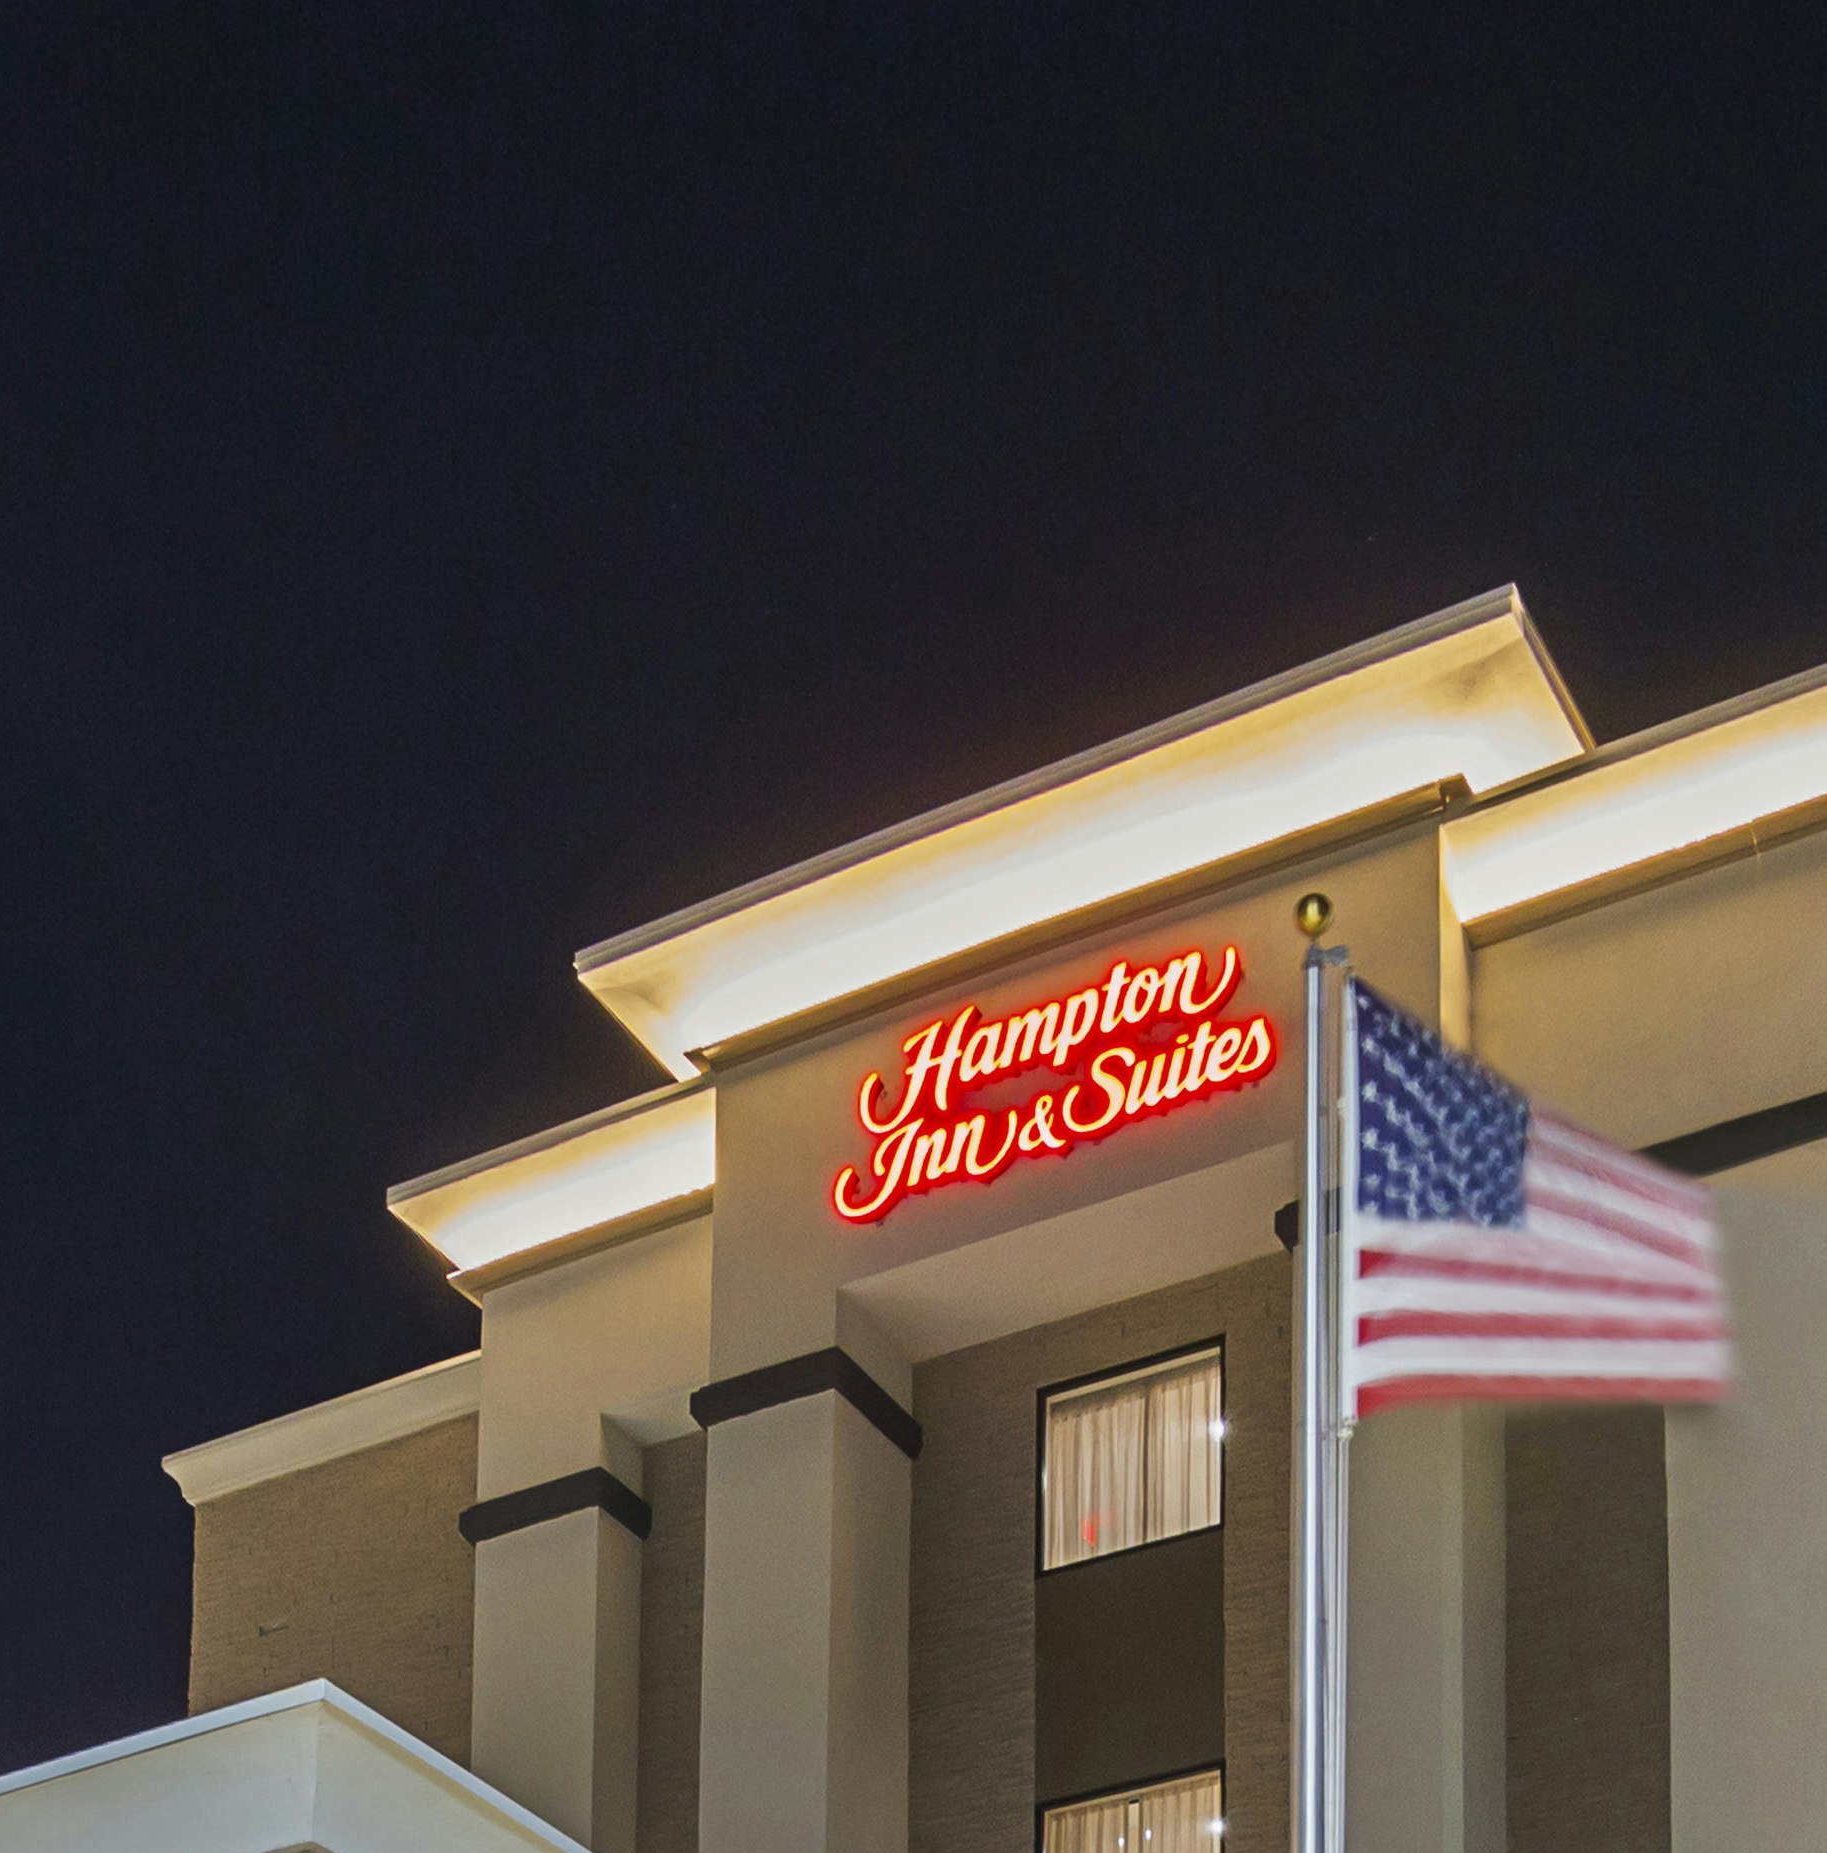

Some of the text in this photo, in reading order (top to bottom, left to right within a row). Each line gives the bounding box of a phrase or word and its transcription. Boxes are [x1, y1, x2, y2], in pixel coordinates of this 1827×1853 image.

[834, 1016, 1275, 1221] Inn & Suites
[860, 946, 1242, 1134] Hampton
